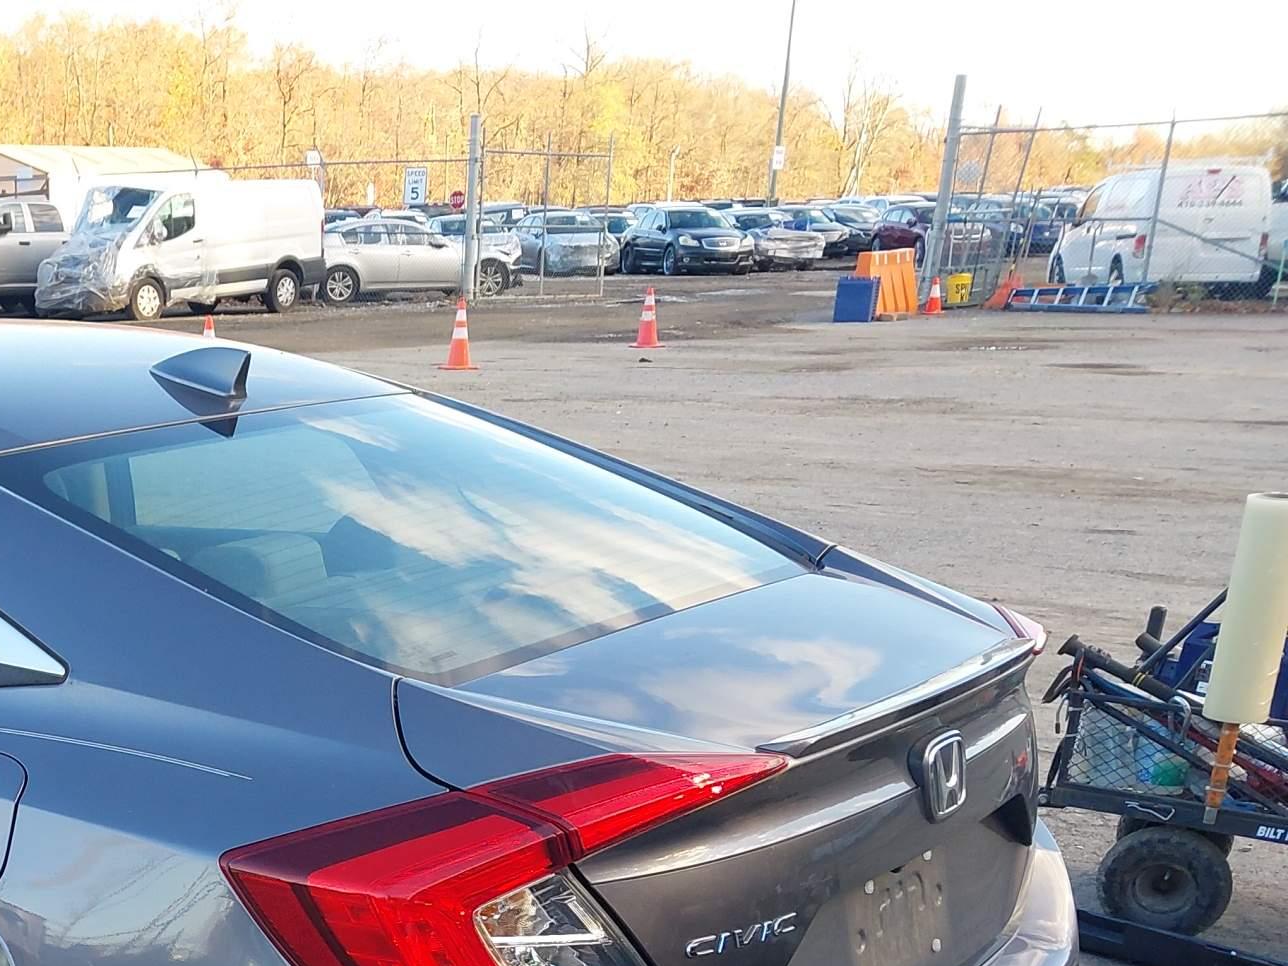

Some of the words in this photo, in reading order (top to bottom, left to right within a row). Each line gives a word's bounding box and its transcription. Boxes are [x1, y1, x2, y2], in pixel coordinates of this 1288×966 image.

[410, 186, 420, 201] 5
[450, 196, 465, 204] STOP
[1255, 825, 1285, 840] BILT
[685, 912, 797, 957] CIVIC
